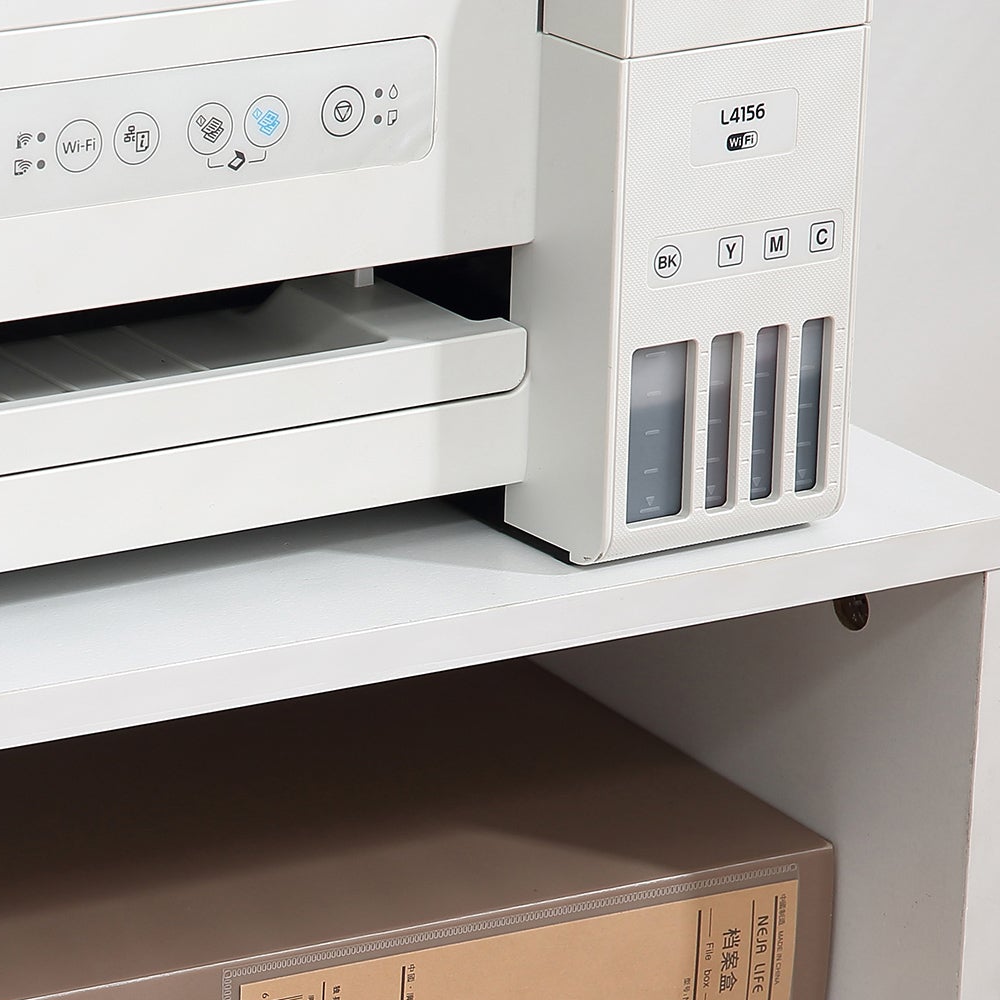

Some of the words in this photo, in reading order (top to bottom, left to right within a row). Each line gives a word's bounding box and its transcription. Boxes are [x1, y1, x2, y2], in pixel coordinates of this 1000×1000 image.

[720, 103, 766, 125] L4156
[62, 138, 96, 155] Wi-Fi
[657, 253, 678, 270] BK
[725, 242, 737, 260] Y
[769, 235, 784, 253] M
[815, 228, 829, 246] C
[755, 915, 770, 955] NEJA
[776, 930, 785, 952] MADE
[705, 941, 715, 961] File
[718, 927, 742, 994] 档案盒
[702, 969, 713, 989] box
[752, 963, 767, 994] LIFE
[774, 962, 782, 985] CHINA
